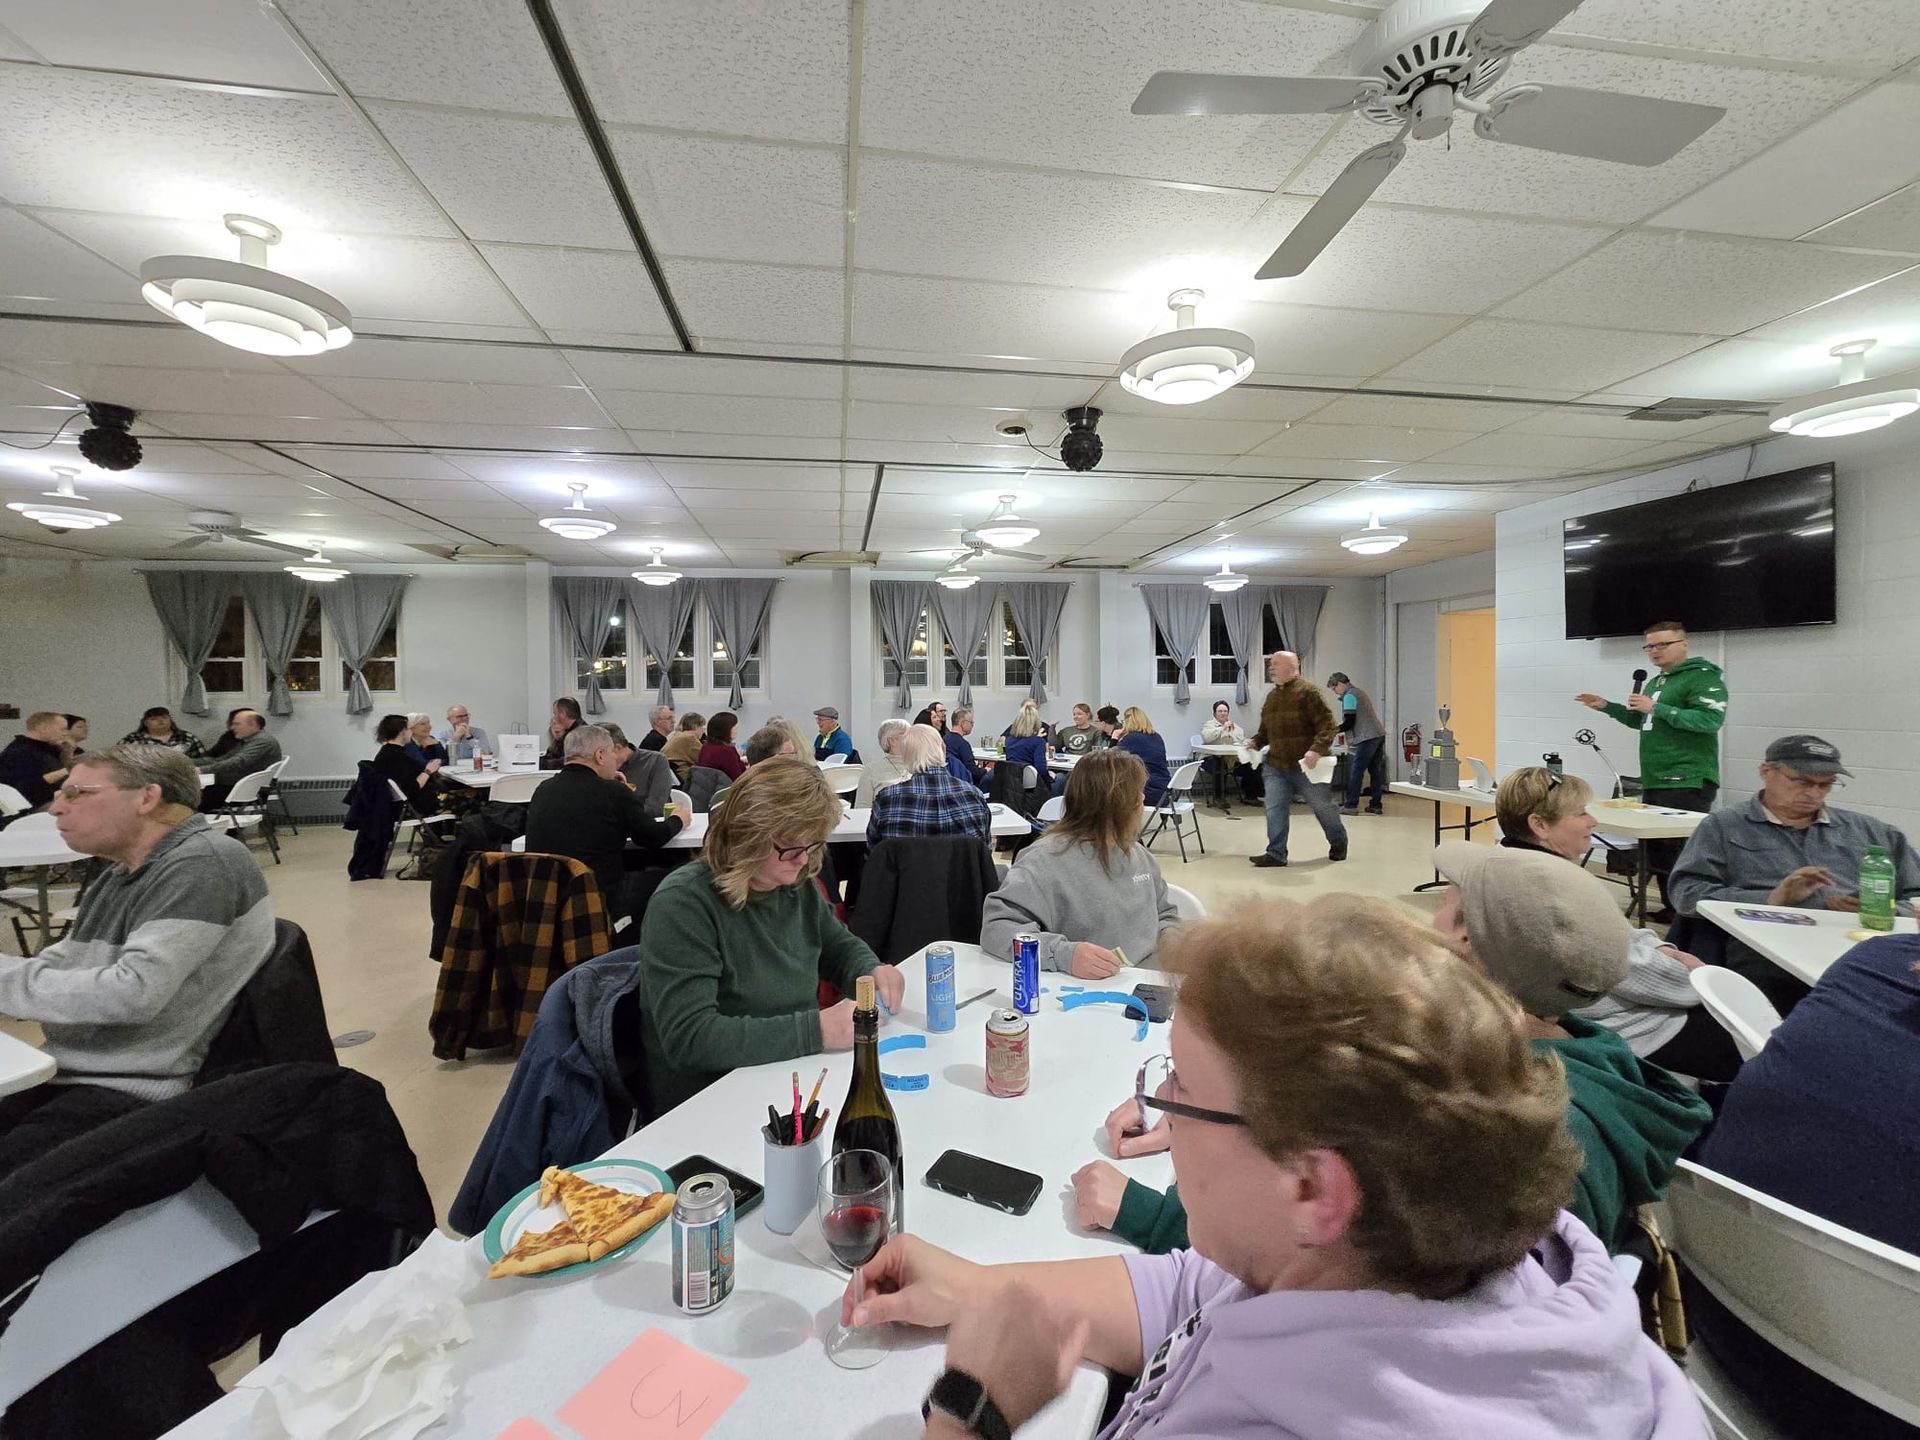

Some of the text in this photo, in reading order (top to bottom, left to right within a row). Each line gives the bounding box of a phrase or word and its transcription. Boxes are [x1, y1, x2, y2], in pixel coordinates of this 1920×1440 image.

[928, 972, 943, 984] BLUE
[1014, 960, 1023, 1001] ULTRA
[930, 991, 955, 1002] LIGHT
